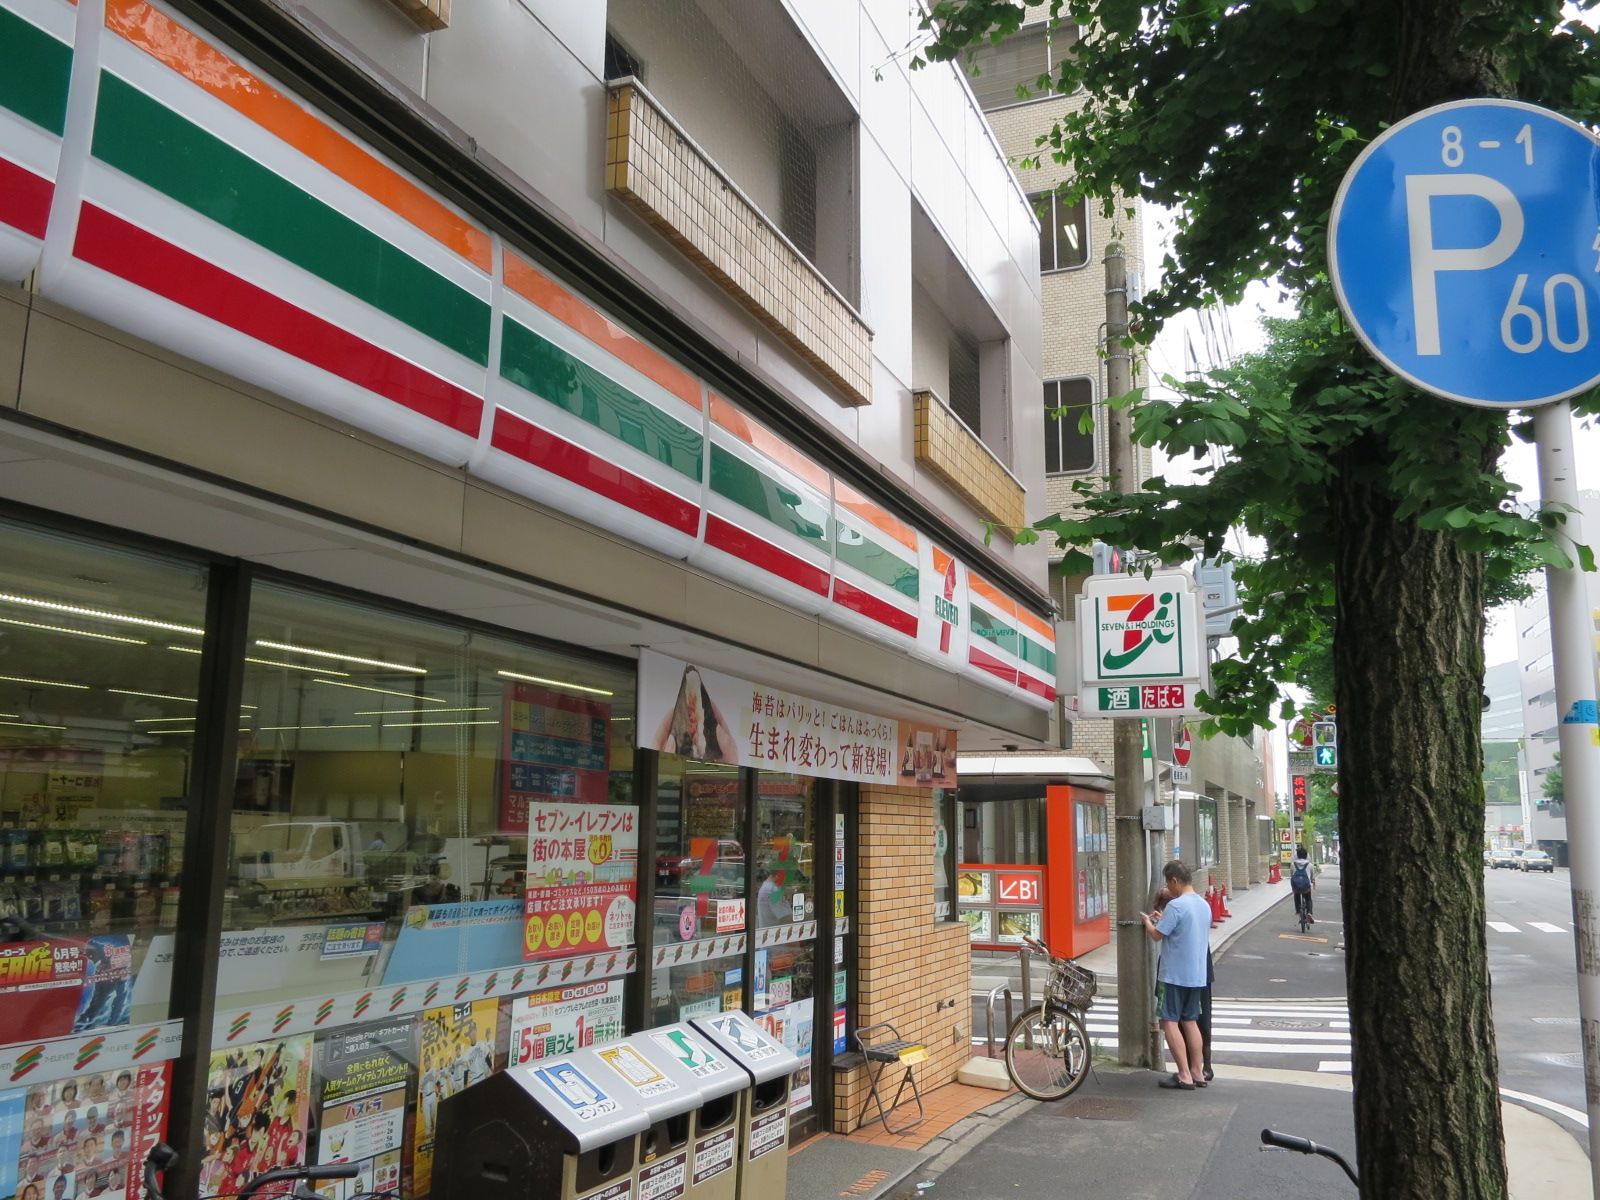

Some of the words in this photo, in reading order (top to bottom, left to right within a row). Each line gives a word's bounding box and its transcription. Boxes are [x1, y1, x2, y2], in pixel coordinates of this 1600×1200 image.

[1405, 173, 1525, 356] P
[1501, 273, 1589, 353] 60
[1135, 619, 1175, 629] HOLDINGS
[1107, 687, 1130, 709] 酒
[1143, 686, 1183, 708] たばこ
[748, 722, 892, 777] 生まれ変わって新登場!
[533, 838, 586, 862] 街の本屋
[1020, 880, 1038, 900] B1
[54, 946, 81, 960] 6月号
[345, 1034, 364, 1044] Google
[364, 1031, 376, 1040] Play
